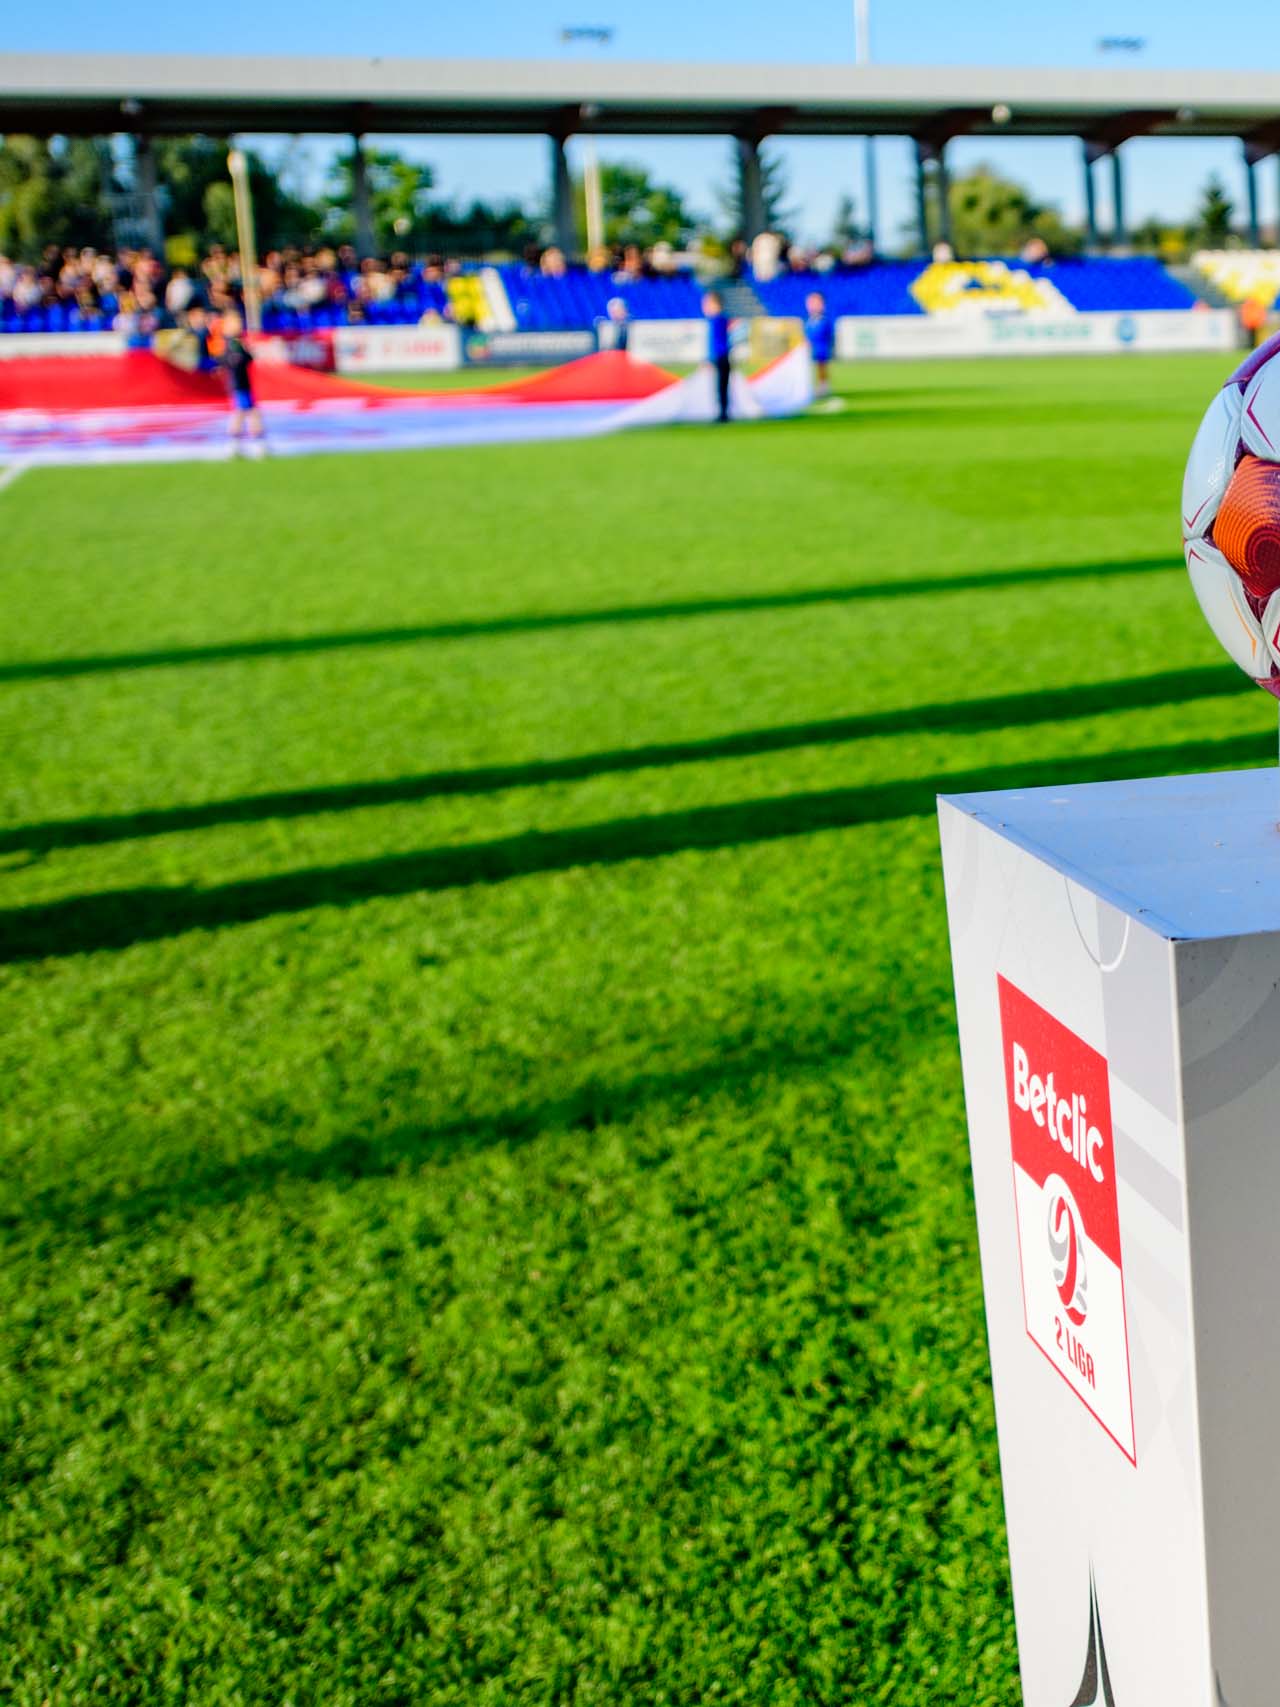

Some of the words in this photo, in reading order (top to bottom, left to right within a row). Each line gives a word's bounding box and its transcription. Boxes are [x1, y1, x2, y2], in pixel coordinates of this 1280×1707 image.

[1013, 1041, 1104, 1183] Betclic
[1054, 1315, 1063, 1349] 2
[1066, 1330, 1096, 1390] LIGA
